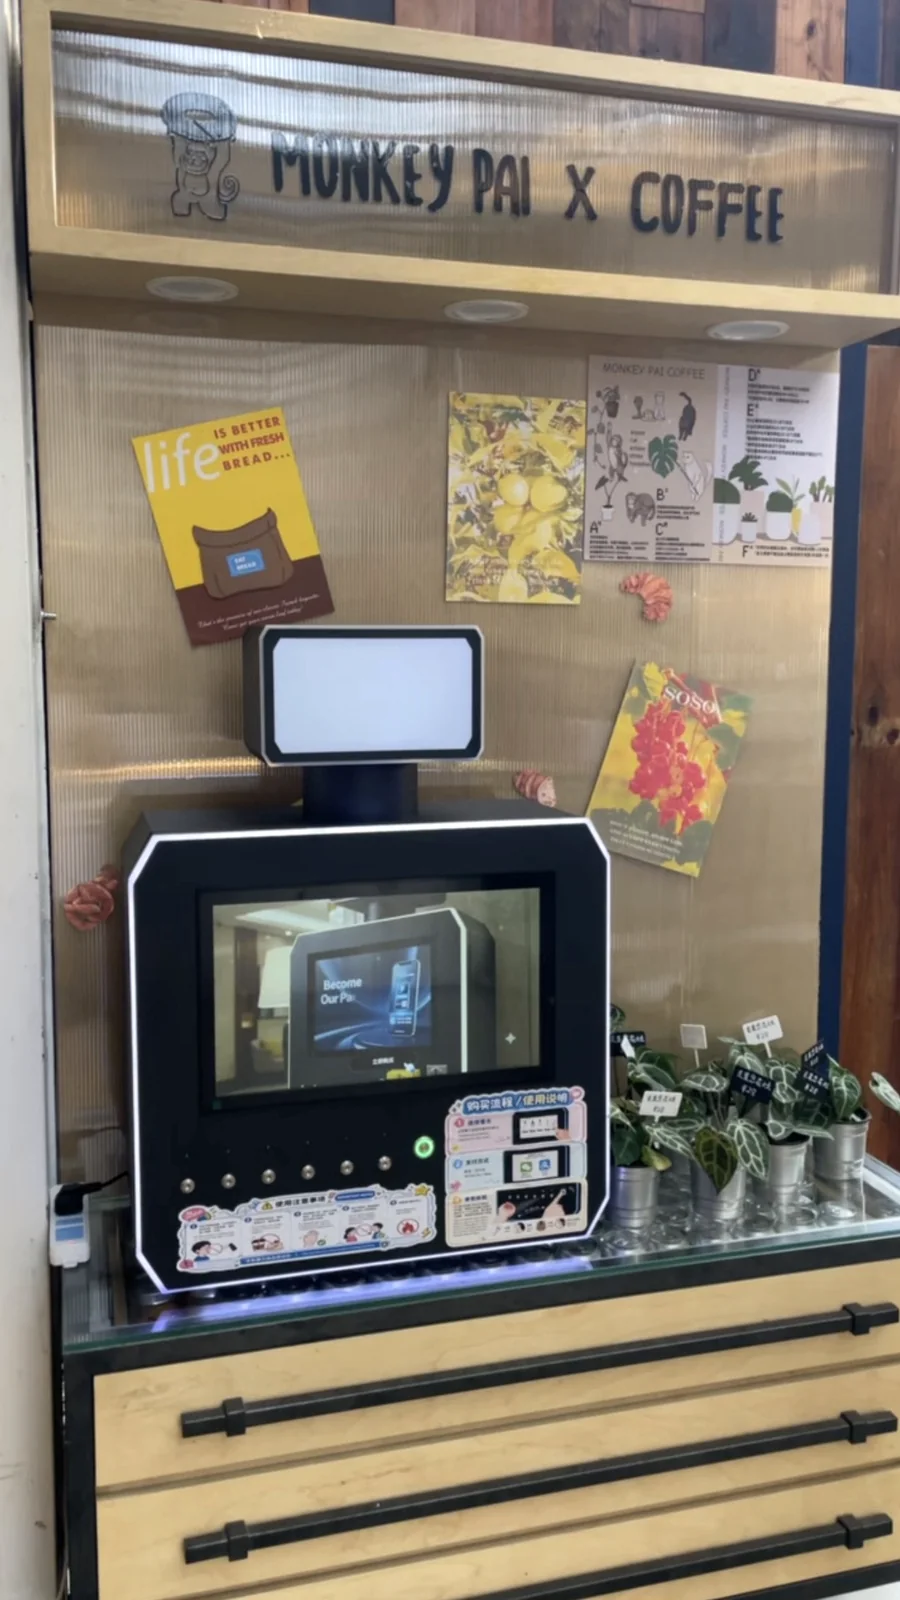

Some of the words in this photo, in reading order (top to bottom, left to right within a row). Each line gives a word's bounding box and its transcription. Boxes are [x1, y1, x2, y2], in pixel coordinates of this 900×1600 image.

[271, 131, 455, 213] MONKEY
[472, 147, 530, 217] PAI
[564, 163, 598, 222] X
[630, 170, 785, 244] COFFEE
[602, 362, 645, 376] MONKEY
[648, 364, 664, 377] PAI
[667, 366, 705, 380] COFFEE
[213, 428, 227, 439] IS
[231, 416, 281, 436] BETTER
[218, 439, 250, 455] WITH
[250, 431, 285, 449] FRESH
[143, 431, 221, 493] life
[664, 686, 715, 714] SOSO
[323, 978, 363, 991] Become
[320, 994, 339, 1005] Our
